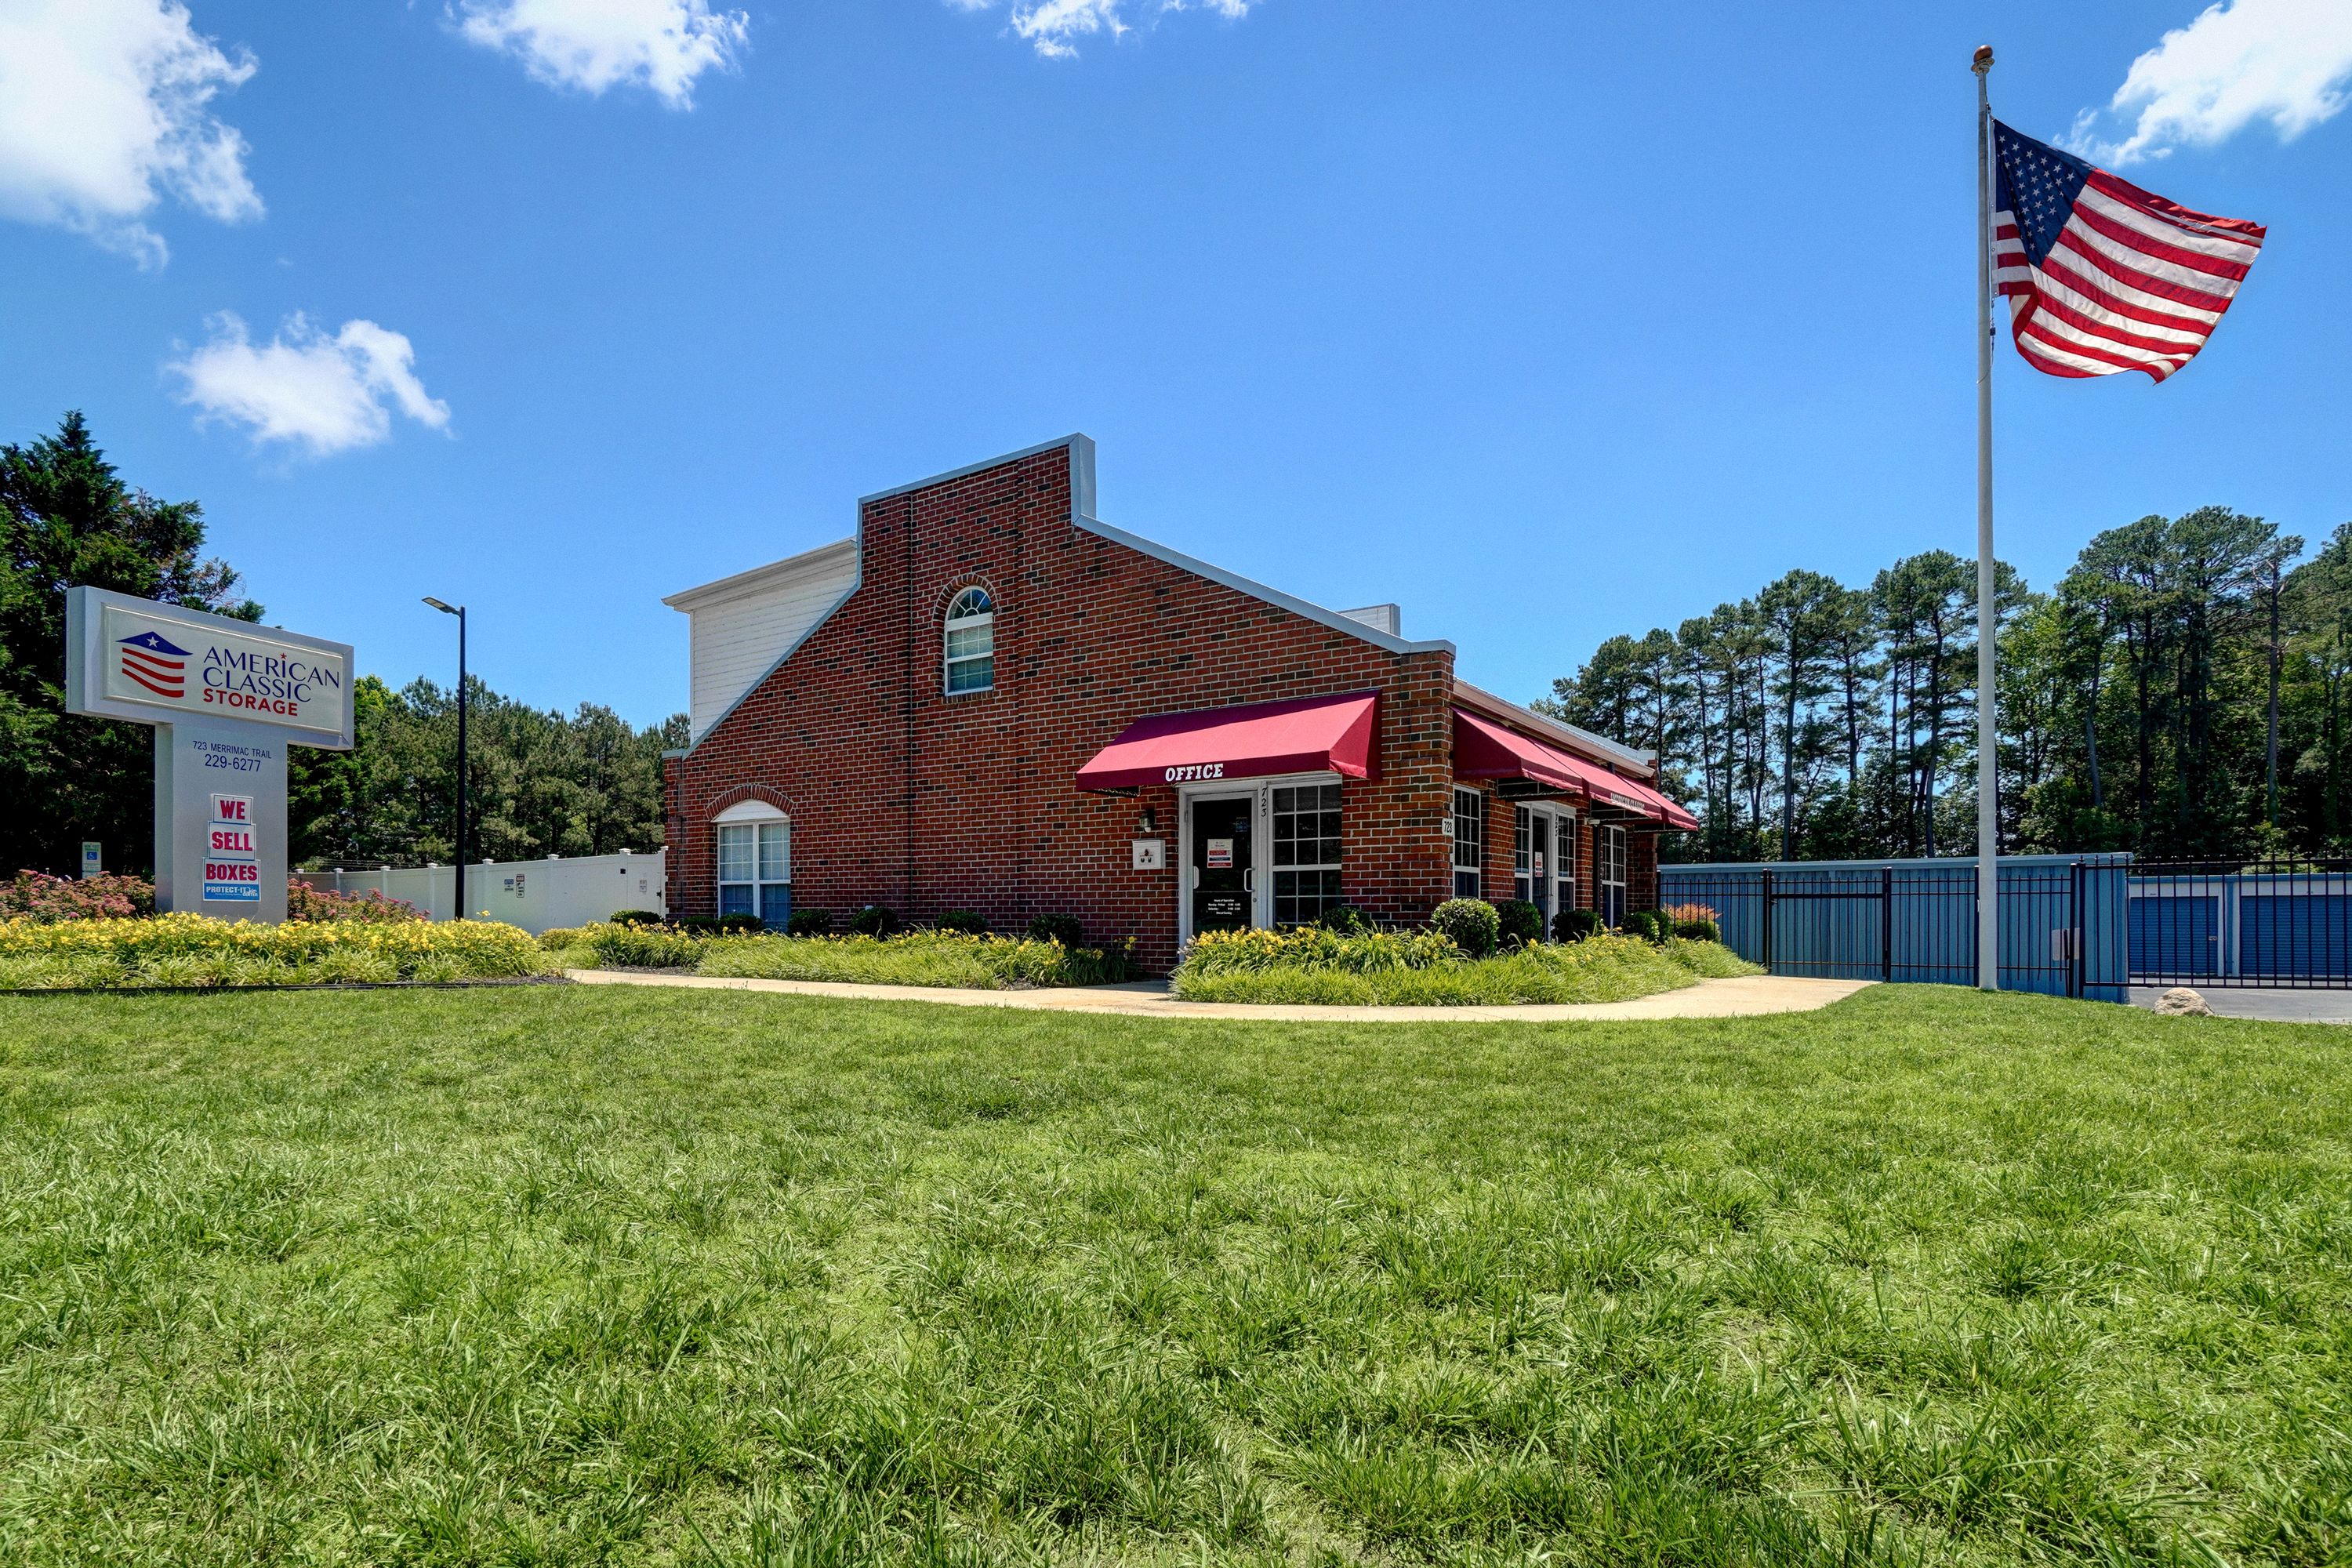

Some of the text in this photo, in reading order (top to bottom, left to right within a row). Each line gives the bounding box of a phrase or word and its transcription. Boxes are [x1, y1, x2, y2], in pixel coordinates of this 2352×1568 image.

[203, 646, 339, 689] AMERICAN
[202, 666, 311, 702] CLASSIC
[202, 688, 298, 717] STORAGE
[192, 740, 272, 759] 723 MERRIMAC TRAIL
[205, 753, 261, 772] 229-6277
[1165, 763, 1224, 782] OFFICE
[220, 800, 245, 820] WE
[1443, 820, 1453, 833] 723
[212, 831, 253, 851] SELL
[205, 863, 258, 881] BOXES
